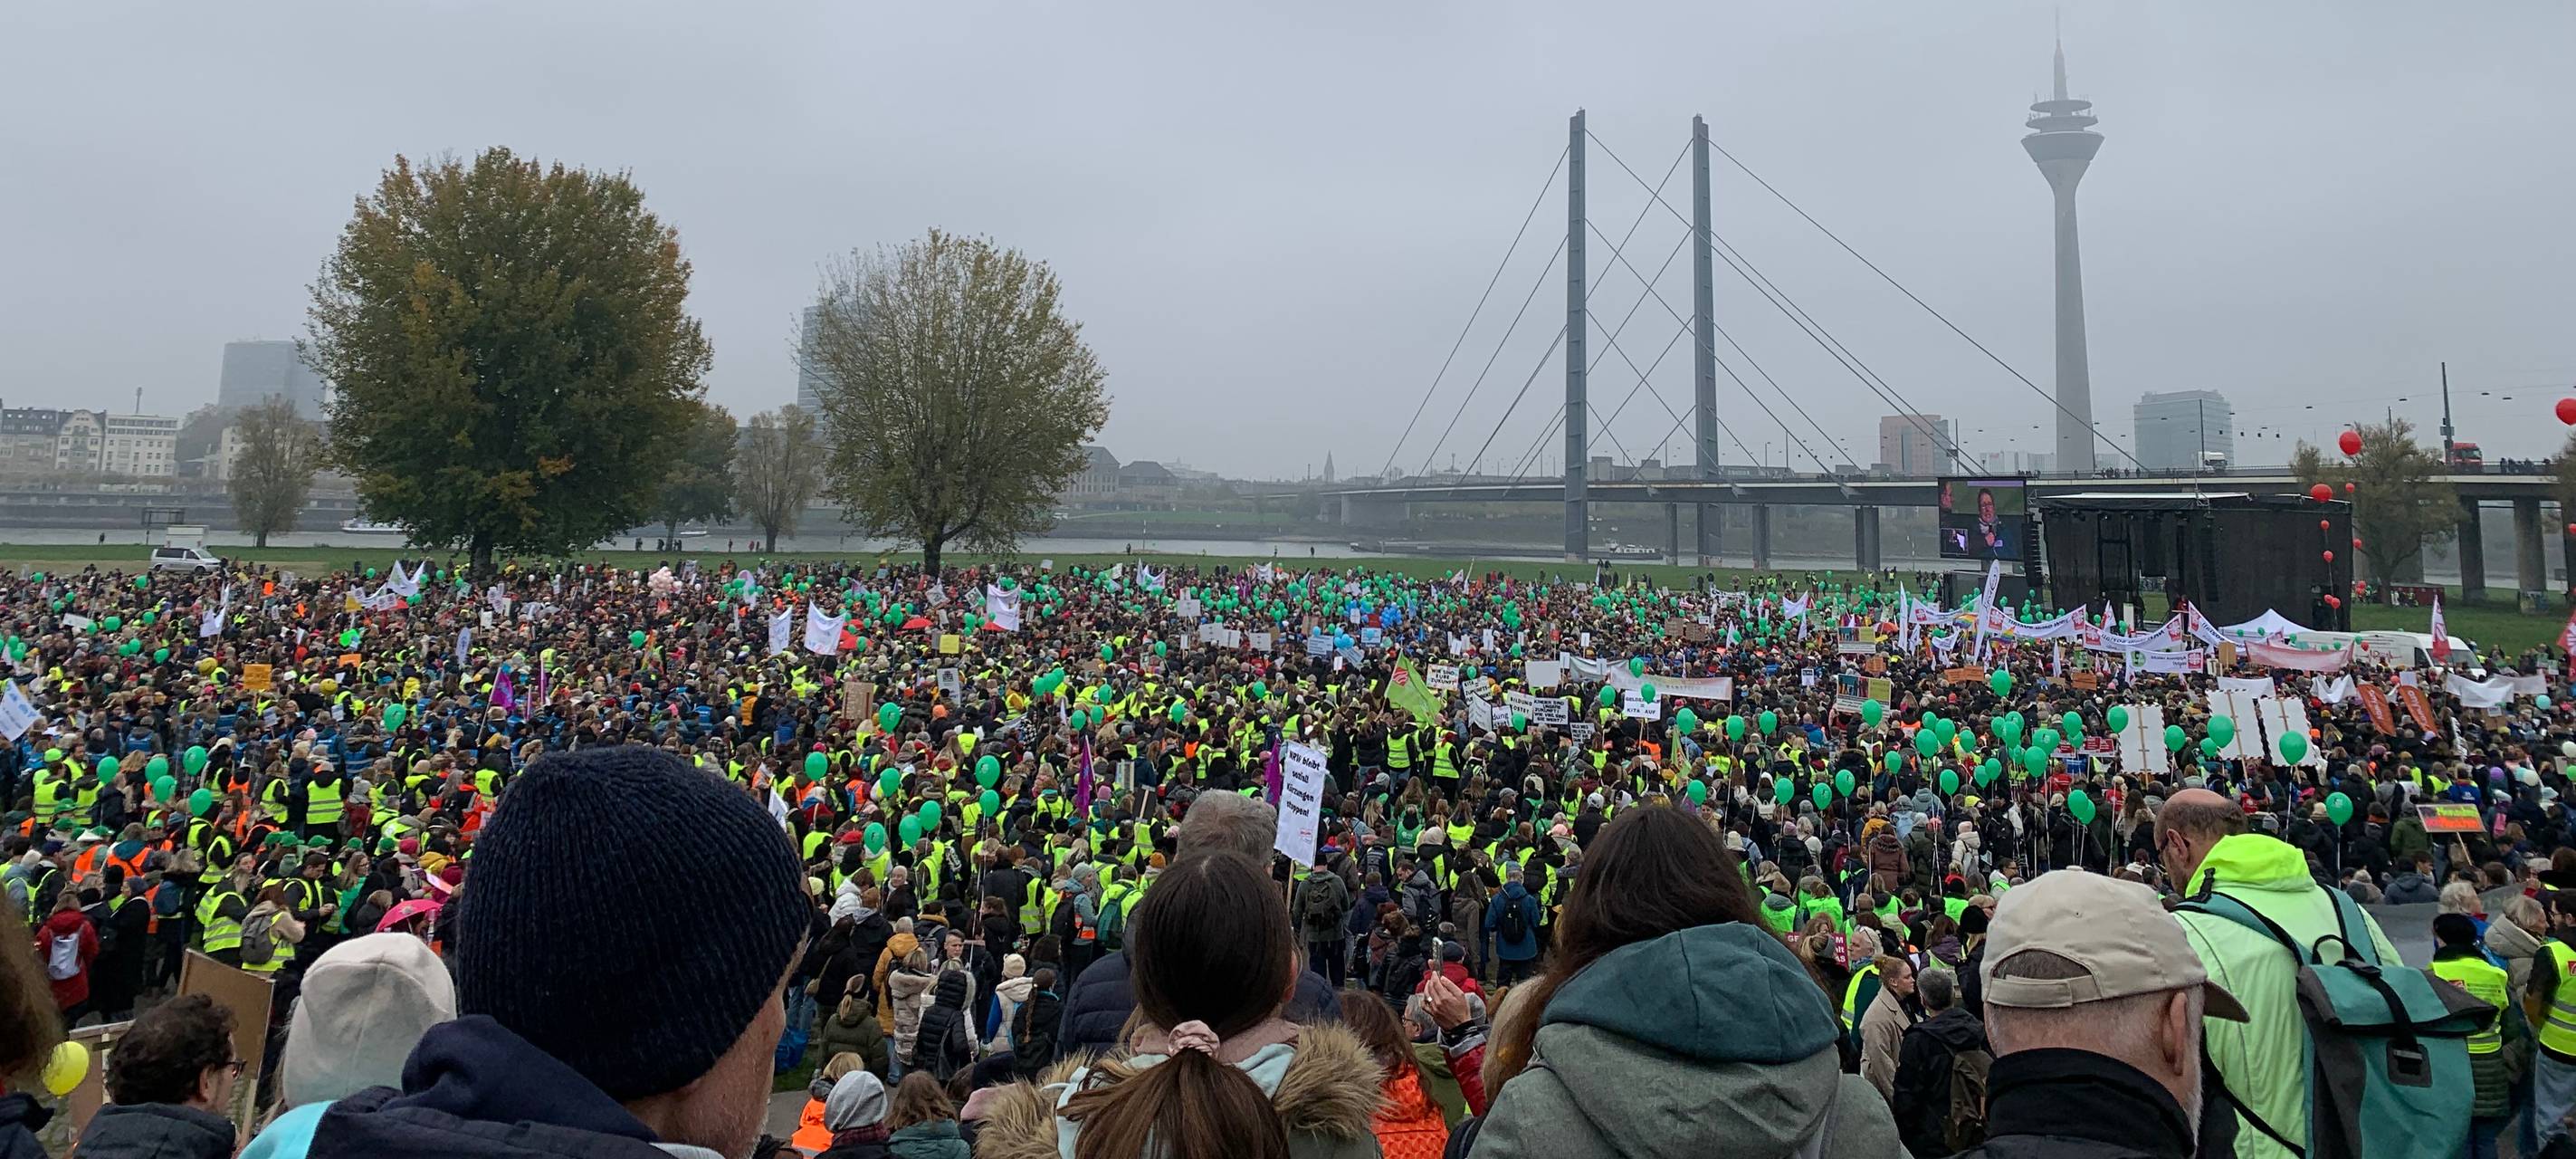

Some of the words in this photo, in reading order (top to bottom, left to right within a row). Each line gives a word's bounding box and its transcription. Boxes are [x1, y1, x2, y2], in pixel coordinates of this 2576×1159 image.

[1510, 696, 1532, 706] BILDUNG
[1512, 705, 1530, 714] OSTET
[1289, 750, 1302, 763] NRW
[1302, 757, 1321, 771] bleibt
[1286, 782, 1314, 802] Kürzungen
[1286, 800, 1310, 818] stoppen!
